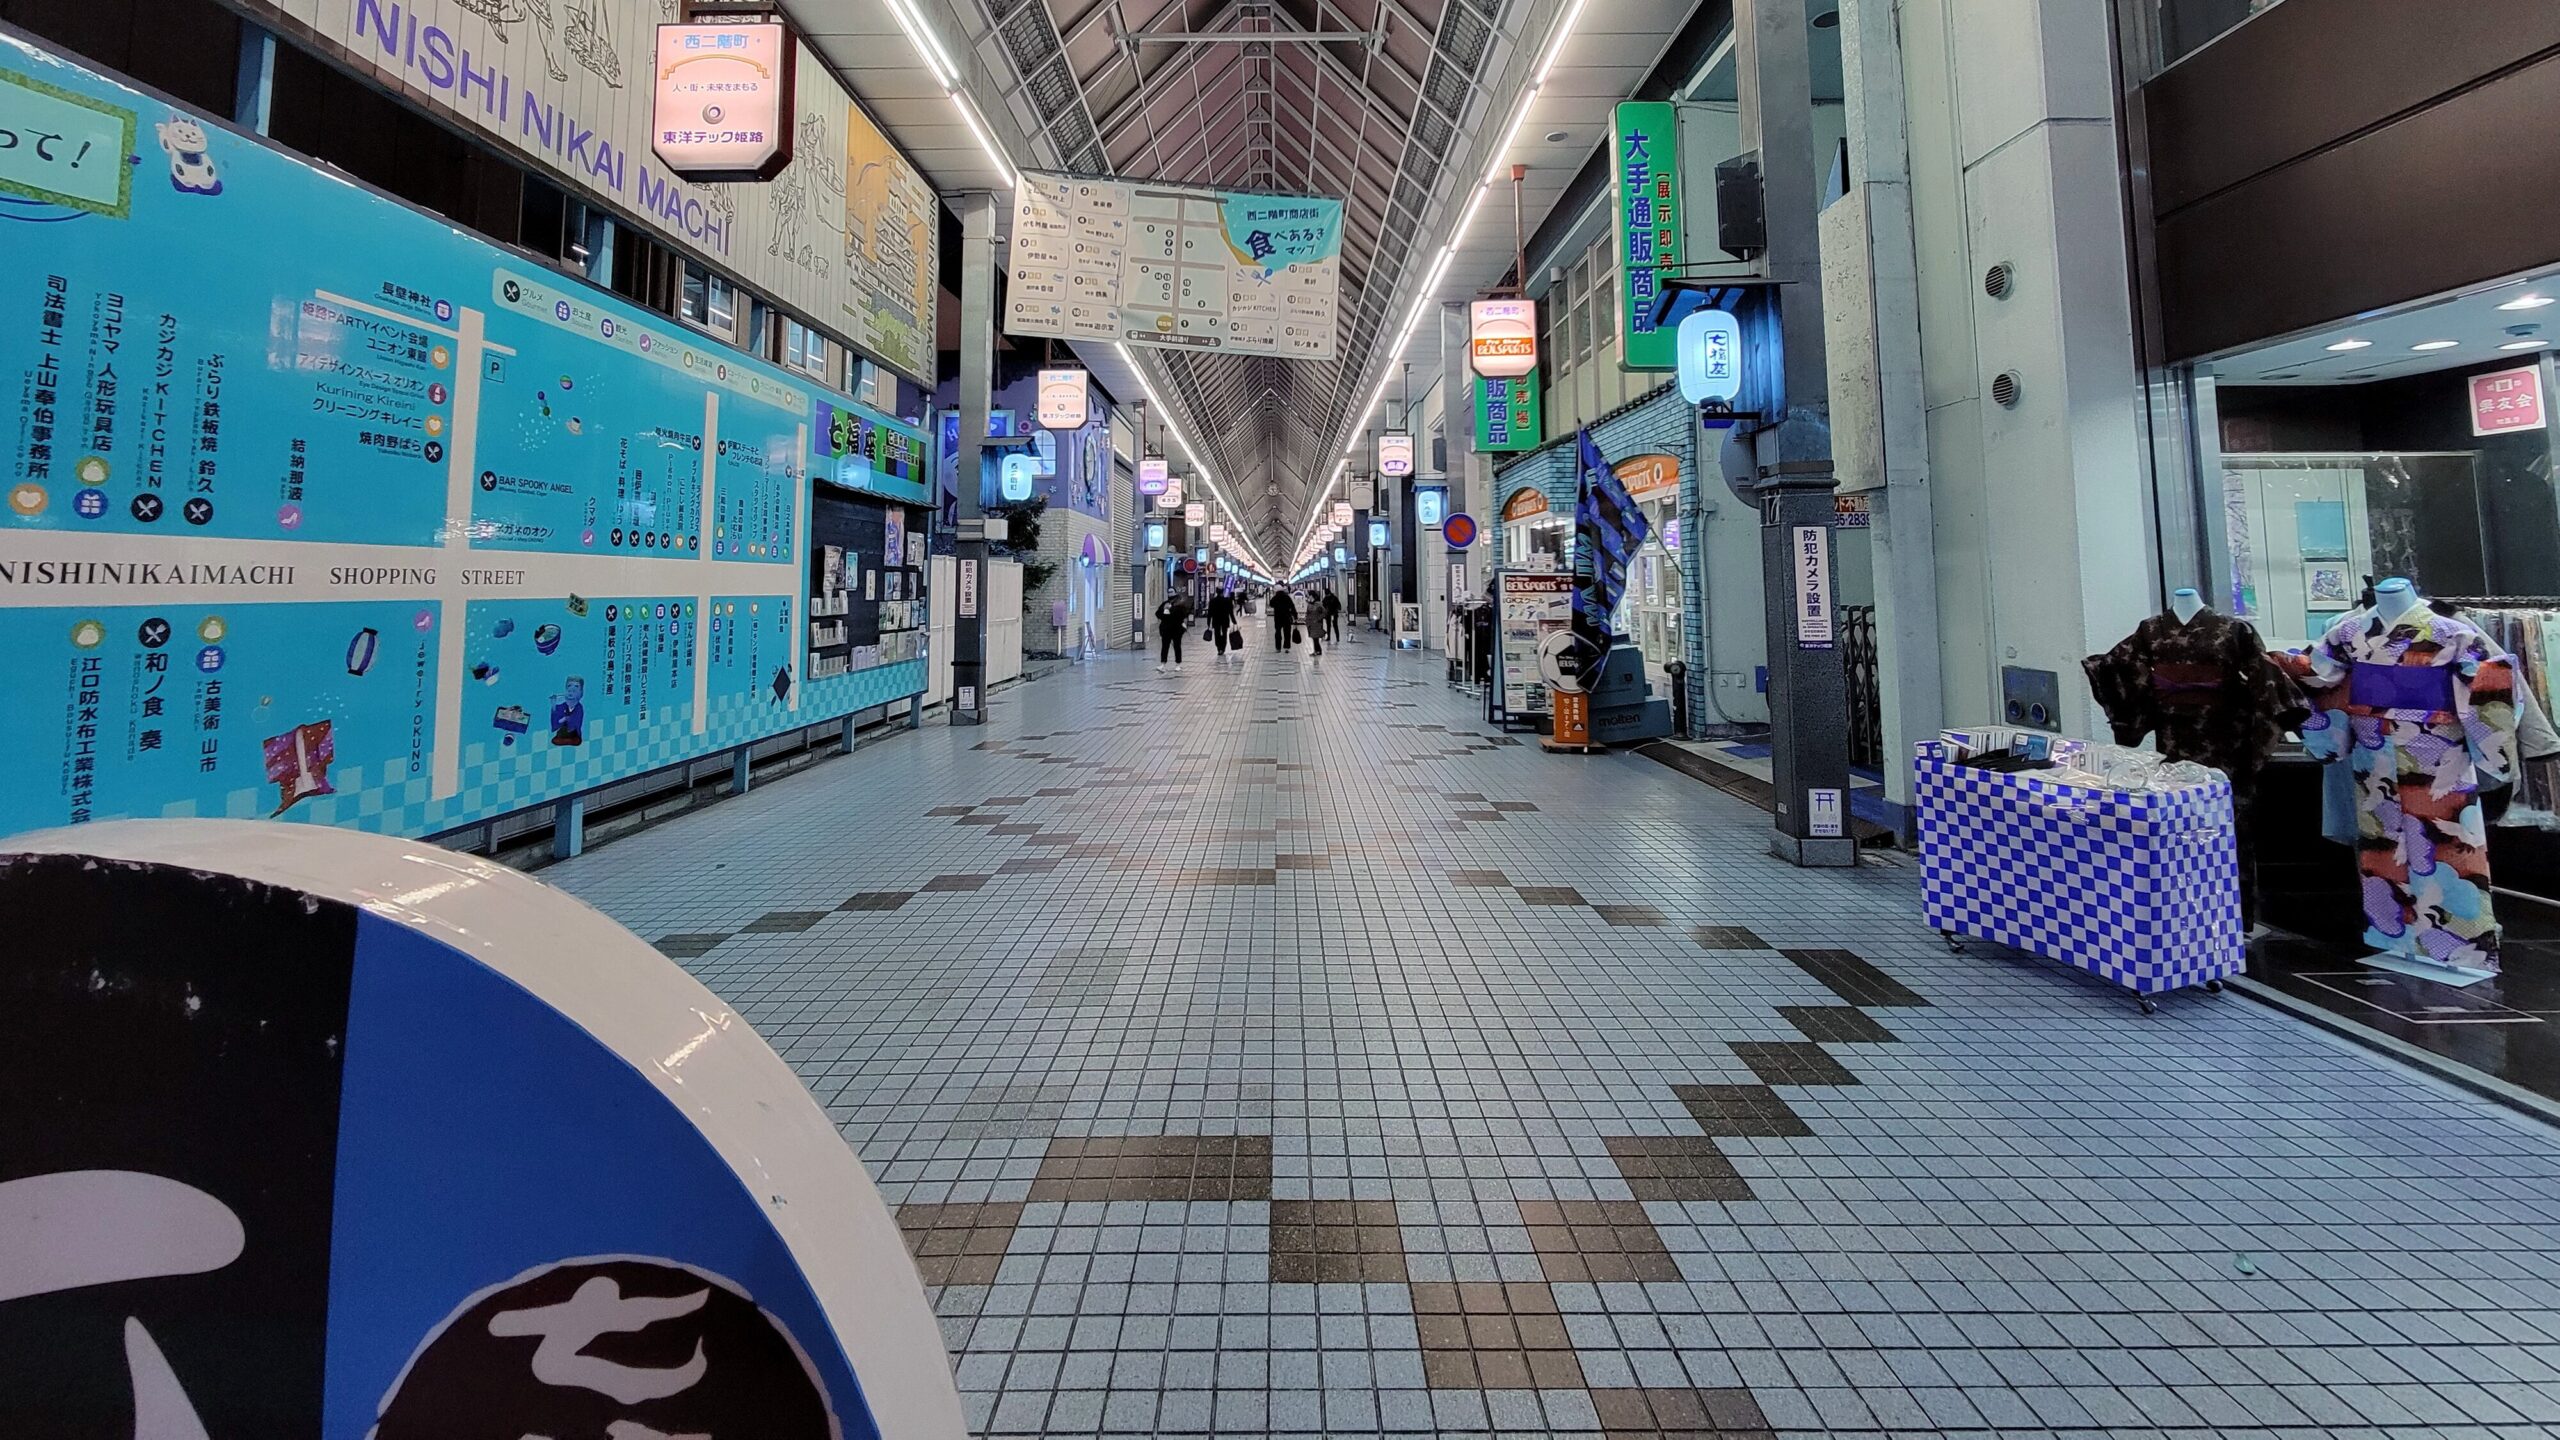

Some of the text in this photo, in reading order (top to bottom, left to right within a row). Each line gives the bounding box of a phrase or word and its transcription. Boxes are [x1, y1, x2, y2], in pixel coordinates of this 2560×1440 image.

[685, 34, 749, 48] 西二階町
[673, 83, 758, 92] 人・街・未来をまもる
[356, 0, 731, 256] NISHI NIKAI MACHI
[663, 131, 763, 143] 東洋テック姫路
[1247, 208, 1319, 221] 西二階町商店街
[1624, 129, 1656, 333] 大手通販商品
[1285, 245, 1315, 255] マップ
[522, 288, 544, 301] グルメ
[925, 193, 936, 384] NISHI NIKAI MACHI
[40, 274, 67, 345] 司法書士
[572, 307, 592, 322] お土産
[91, 293, 124, 452] ヨコヤマ 人形玩具店
[491, 361, 500, 374] P
[200, 354, 225, 452] ぶらり鉄板焼
[316, 382, 416, 410] Kurining Kireini
[312, 398, 423, 429] クリーニングキレイニ
[359, 431, 421, 452] 焼肉野ばら
[499, 476, 574, 494] BAR SPOOKY ANGEL
[588, 497, 596, 526] クマダ
[0, 561, 526, 585] NISHINIKAIMACHI SHOPPING STREET
[1803, 530, 1822, 617] 防犯カメラ設置
[411, 639, 425, 772] jewelry OKUNO
[200, 680, 222, 772] 古美術 山市
